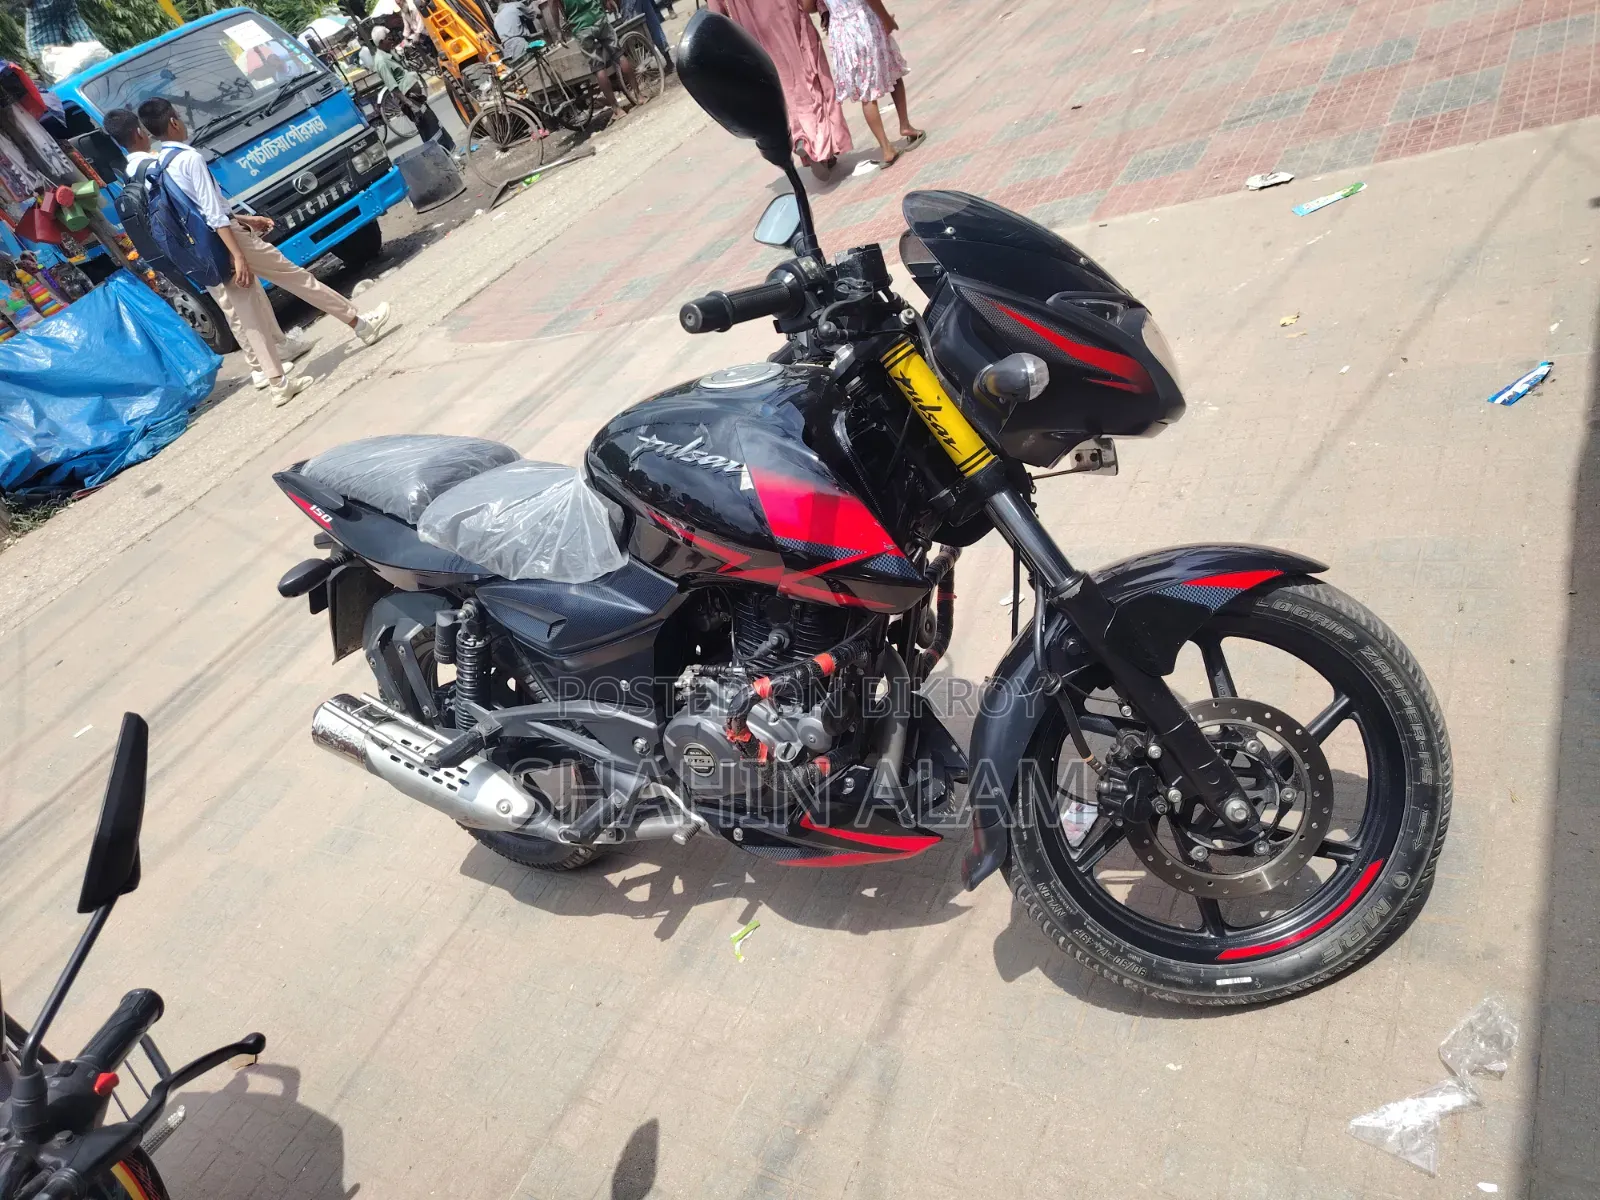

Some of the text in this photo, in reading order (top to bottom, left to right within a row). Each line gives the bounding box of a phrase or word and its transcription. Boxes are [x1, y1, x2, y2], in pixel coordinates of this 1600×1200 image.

[285, 115, 328, 147] পৌরসভা
[284, 179, 353, 229] EICHER
[310, 504, 333, 523] 150
[1036, 882, 1067, 918] NYLON
[1321, 897, 1393, 964] MRF
